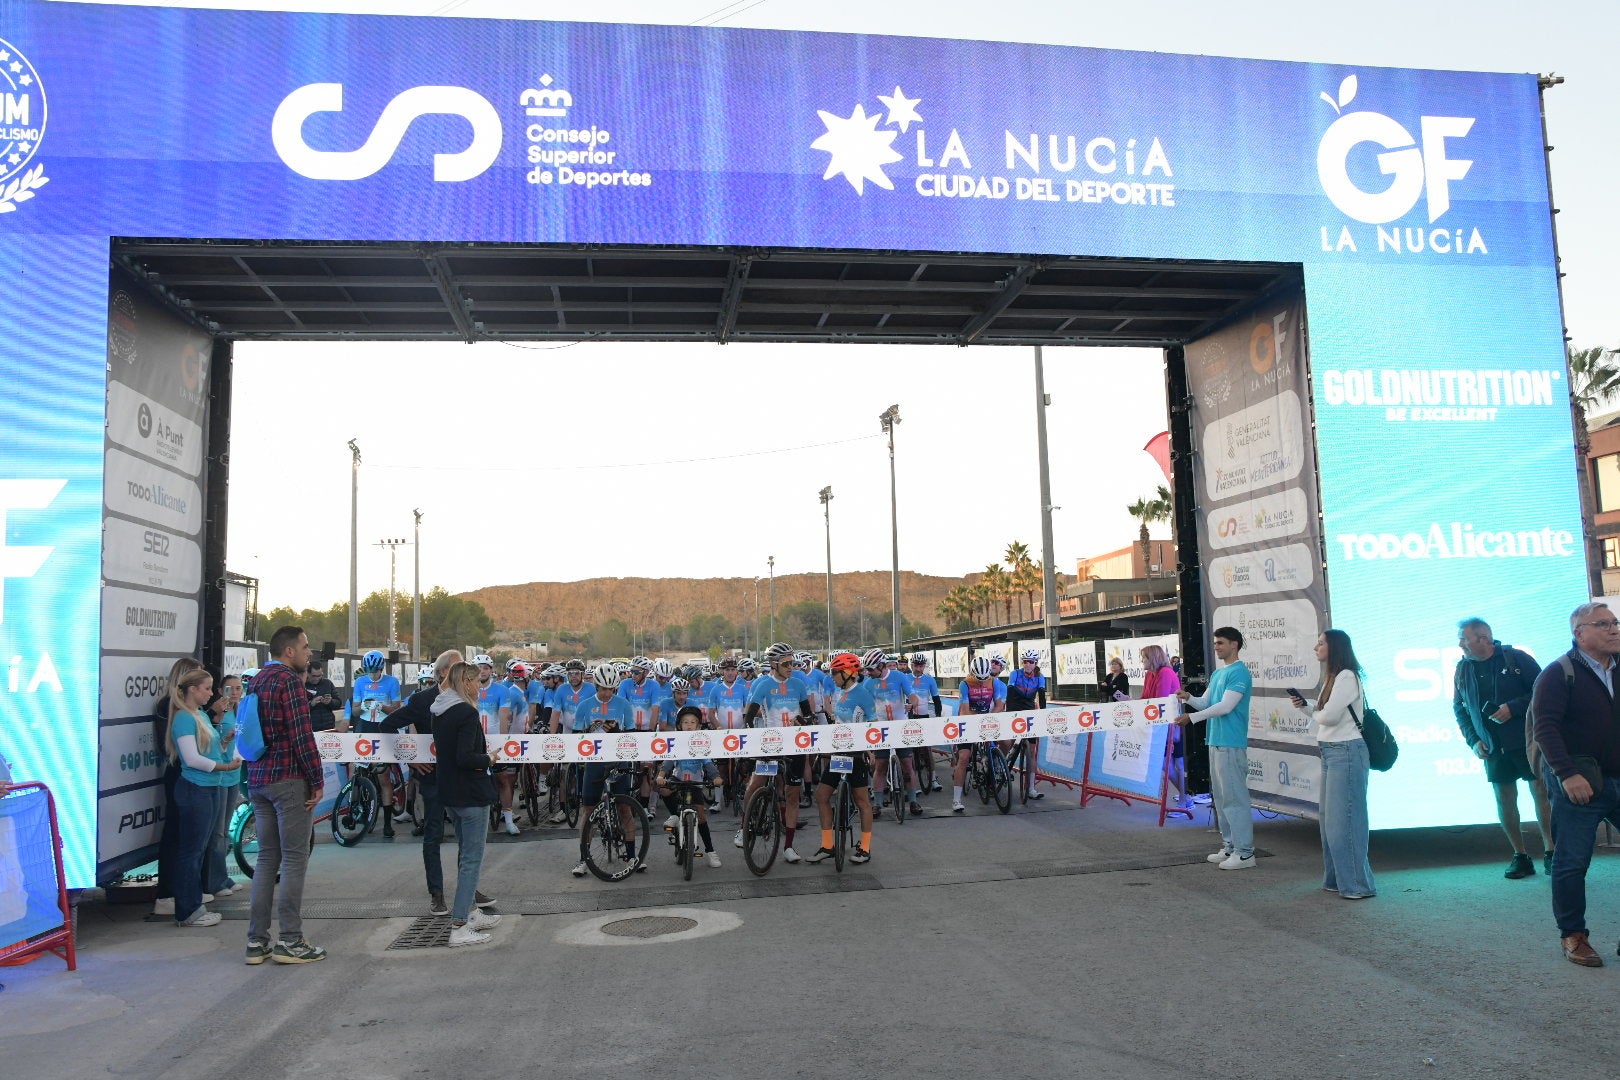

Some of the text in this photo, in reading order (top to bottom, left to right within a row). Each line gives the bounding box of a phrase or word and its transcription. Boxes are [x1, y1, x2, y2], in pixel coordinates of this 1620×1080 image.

[526, 123, 610, 148] Consejo
[527, 145, 617, 168] Superior
[916, 128, 972, 169] LA
[526, 166, 652, 189] de Deportes
[1317, 110, 1476, 225] GF
[915, 173, 1175, 207] CIUDAD DEL DEPORTE
[1320, 225, 1358, 253] LA
[1385, 407, 1498, 422] BE EXCELLENT
[165, 425, 184, 448] Punt
[127, 480, 187, 515] TODOAlicante
[143, 530, 170, 557] SER
[1336, 521, 1576, 560] TODOAlicante
[125, 606, 177, 630] GOLDNUTRITION
[125, 675, 168, 699] GSPOR
[1078, 710, 1101, 728] GF
[1144, 703, 1166, 721] GF
[865, 727, 889, 745] GF
[943, 722, 966, 740] GF
[1012, 716, 1034, 734] GF
[1397, 723, 1452, 744] Radio
[355, 738, 380, 757] GF
[503, 740, 529, 757] GF
[577, 739, 602, 756] GF
[651, 737, 676, 755] GF
[723, 734, 748, 751] GF
[795, 731, 819, 749] GF
